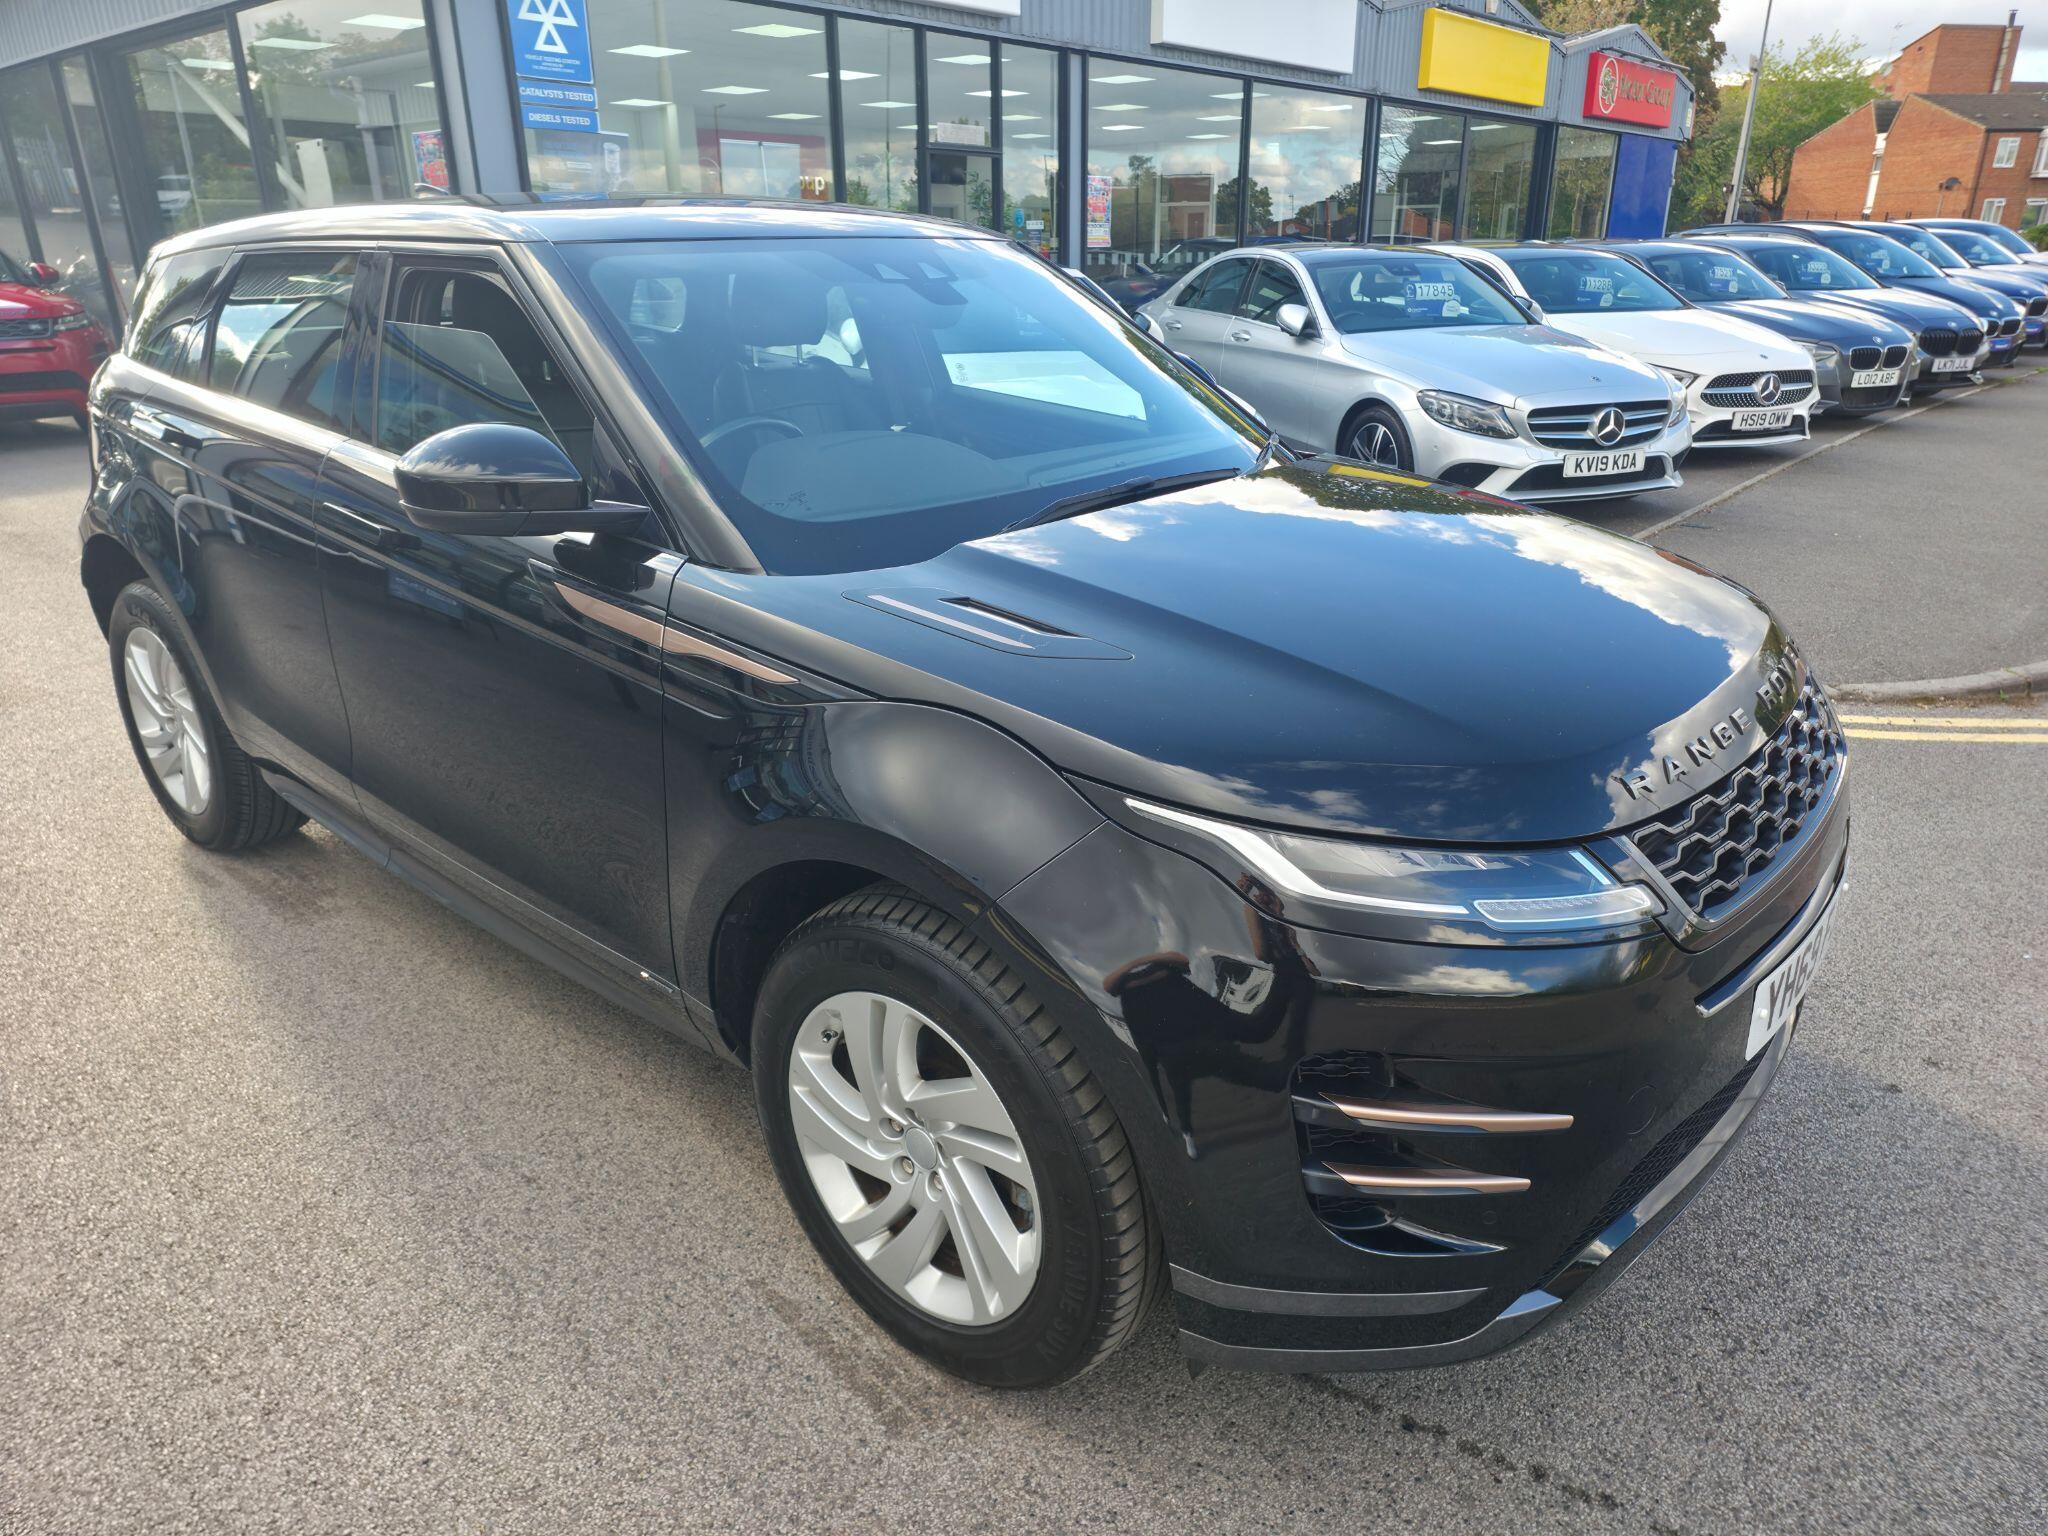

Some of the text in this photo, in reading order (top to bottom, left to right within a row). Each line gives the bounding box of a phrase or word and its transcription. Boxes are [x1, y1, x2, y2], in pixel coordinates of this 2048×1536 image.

[520, 87, 594, 102] CATALYSTS TESTED
[1646, 80, 1671, 112] Group
[528, 112, 591, 126] DIESELS TESTED
[1740, 412, 1768, 428] HS19
[1574, 452, 1637, 474] KV19 KDA
[1618, 707, 1751, 800] RANGE
